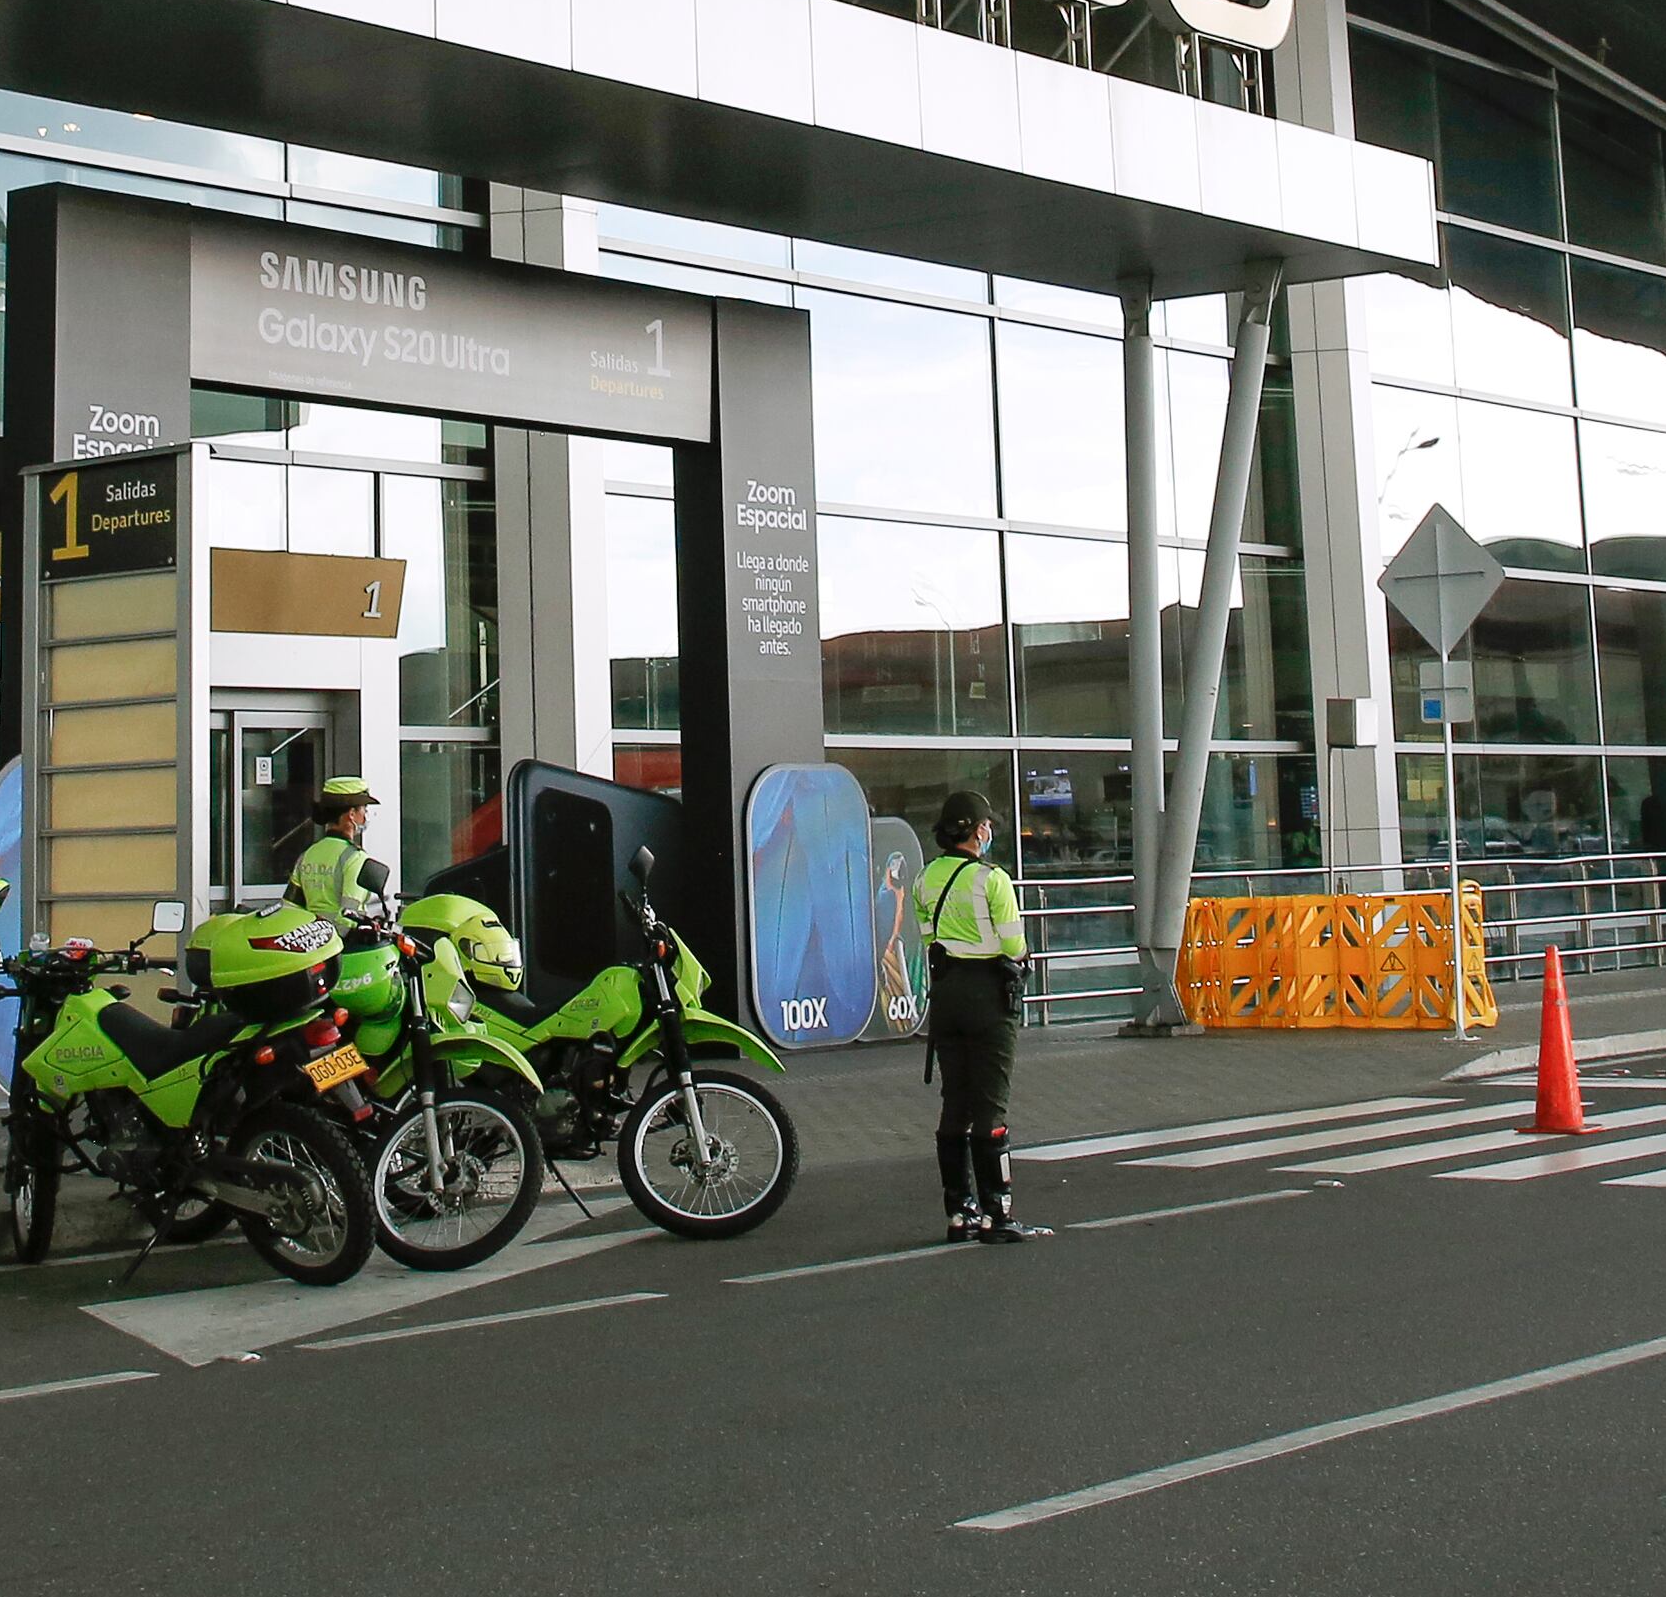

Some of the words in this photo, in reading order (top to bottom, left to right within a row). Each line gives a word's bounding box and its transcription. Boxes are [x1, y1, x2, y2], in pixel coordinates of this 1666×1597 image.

[259, 251, 427, 311] SAMSUNG
[258, 308, 376, 367] Galaxy
[383, 326, 434, 365] S20
[440, 332, 511, 377] Ultra
[645, 318, 671, 378] 1
[590, 350, 638, 374] Salidas
[590, 373, 665, 401] Departures
[89, 404, 160, 438] Zoom
[106, 481, 157, 503] Salidas
[747, 480, 796, 505] Zoom
[50, 471, 90, 561] 1
[92, 509, 171, 535] Departures
[737, 504, 807, 534] Espacial
[737, 551, 764, 574] Llega
[767, 558, 774, 570] a
[776, 554, 809, 573] donde
[362, 580, 382, 618] 1
[755, 575, 792, 596] ningún
[742, 596, 807, 616] smartphone
[748, 615, 763, 633] ha
[763, 615, 802, 638] llegado
[759, 639, 792, 655] antes.
[781, 997, 829, 1032] 100X
[887, 994, 919, 1021] 60X
